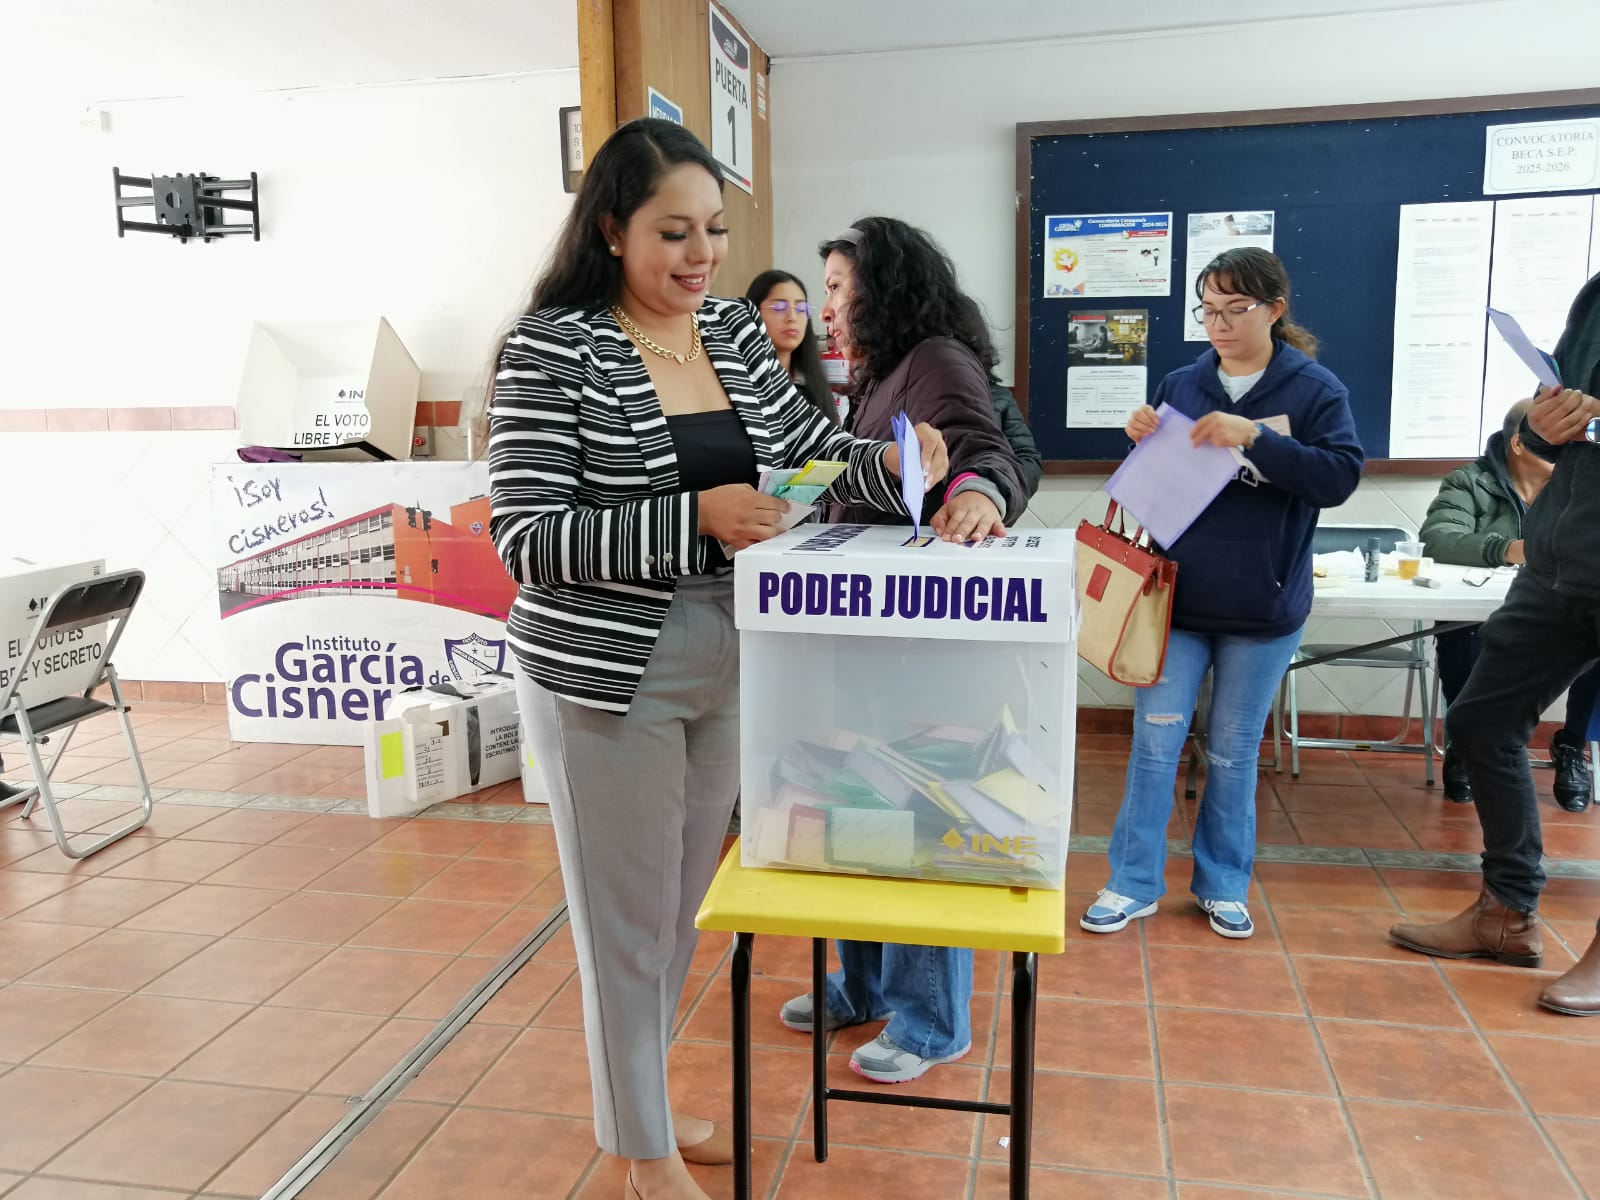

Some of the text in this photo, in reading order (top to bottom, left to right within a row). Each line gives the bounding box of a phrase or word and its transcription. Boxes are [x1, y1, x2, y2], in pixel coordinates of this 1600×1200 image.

[715, 57, 748, 110] PUERTA
[727, 105, 737, 167] 1
[1496, 131, 1595, 147] CONVOCATORIA
[1511, 146, 1577, 160] BECA S.E.P.
[1516, 162, 1571, 174] 2025-2026
[348, 390, 364, 399] IN
[315, 414, 369, 427] EL VOTO
[293, 432, 331, 445] LIBRE
[334, 432, 343, 445] Y
[759, 571, 1048, 622] PODER JUDICIAL
[36, 630, 65, 651] OTO
[306, 635, 381, 651] Instituto
[32, 659, 41, 678] Y
[44, 642, 102, 675] SECRETO
[275, 642, 450, 686] García de
[231, 672, 392, 722] Cisner
[971, 833, 1038, 856] INE
